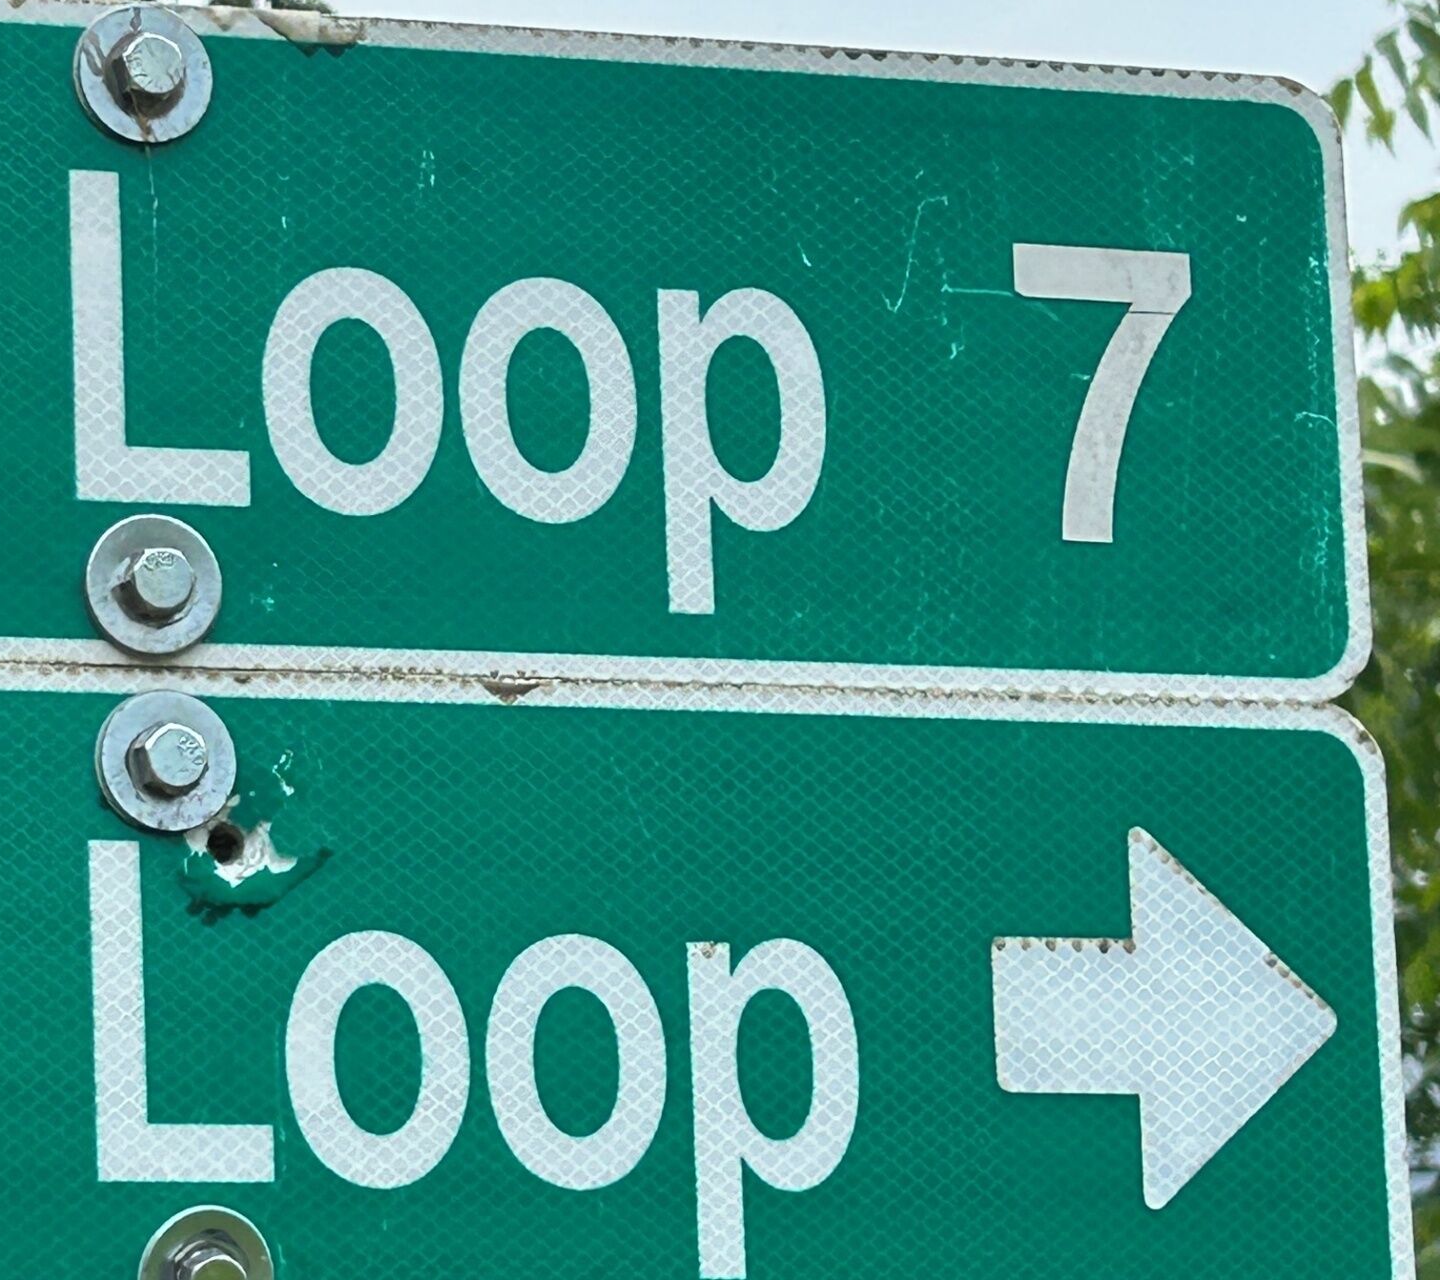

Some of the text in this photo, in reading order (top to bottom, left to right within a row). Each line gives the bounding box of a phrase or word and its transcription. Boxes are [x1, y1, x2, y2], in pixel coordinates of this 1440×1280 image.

[71, 170, 1193, 615] Loop 7
[89, 841, 859, 1278] Loop
